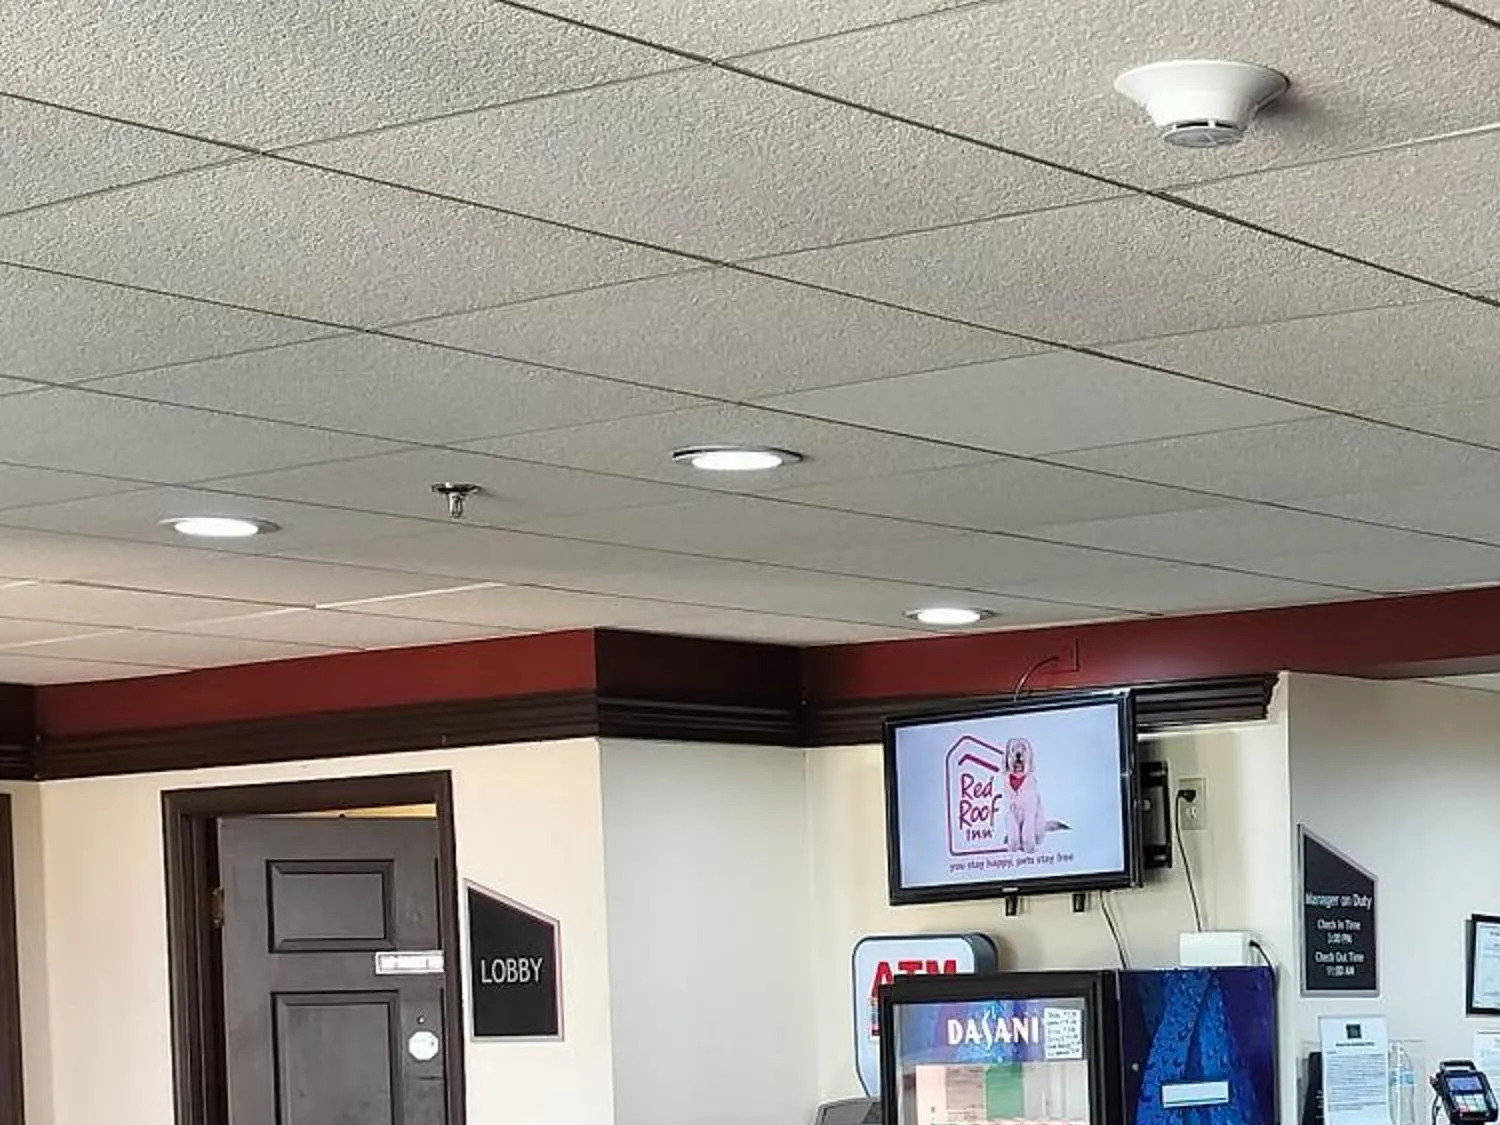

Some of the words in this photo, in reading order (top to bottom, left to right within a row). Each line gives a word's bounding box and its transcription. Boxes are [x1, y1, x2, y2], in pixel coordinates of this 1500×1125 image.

[960, 773, 994, 800] Red
[959, 794, 1003, 830] Roof
[1352, 893, 1373, 910] Duty
[480, 957, 544, 984] LOBBY
[1348, 951, 1365, 963] Time
[947, 1010, 1039, 1050] DASANI
